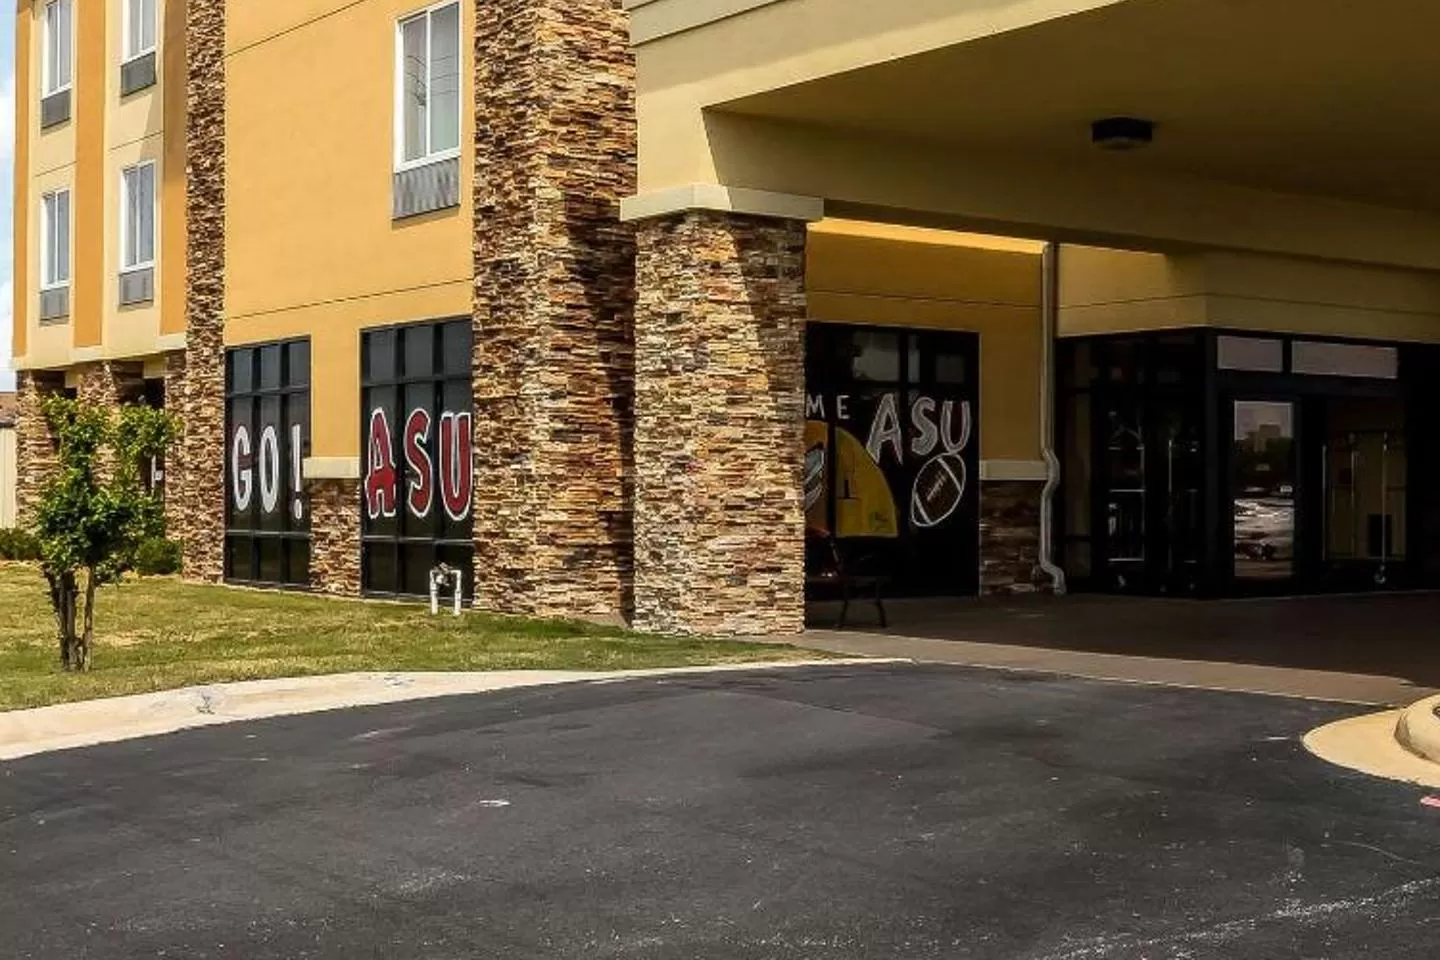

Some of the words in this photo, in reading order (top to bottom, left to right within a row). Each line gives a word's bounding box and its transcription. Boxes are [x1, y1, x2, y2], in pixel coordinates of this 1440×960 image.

[232, 424, 303, 520] GO!
[365, 407, 473, 521] ASU
[866, 393, 972, 466] ASU
